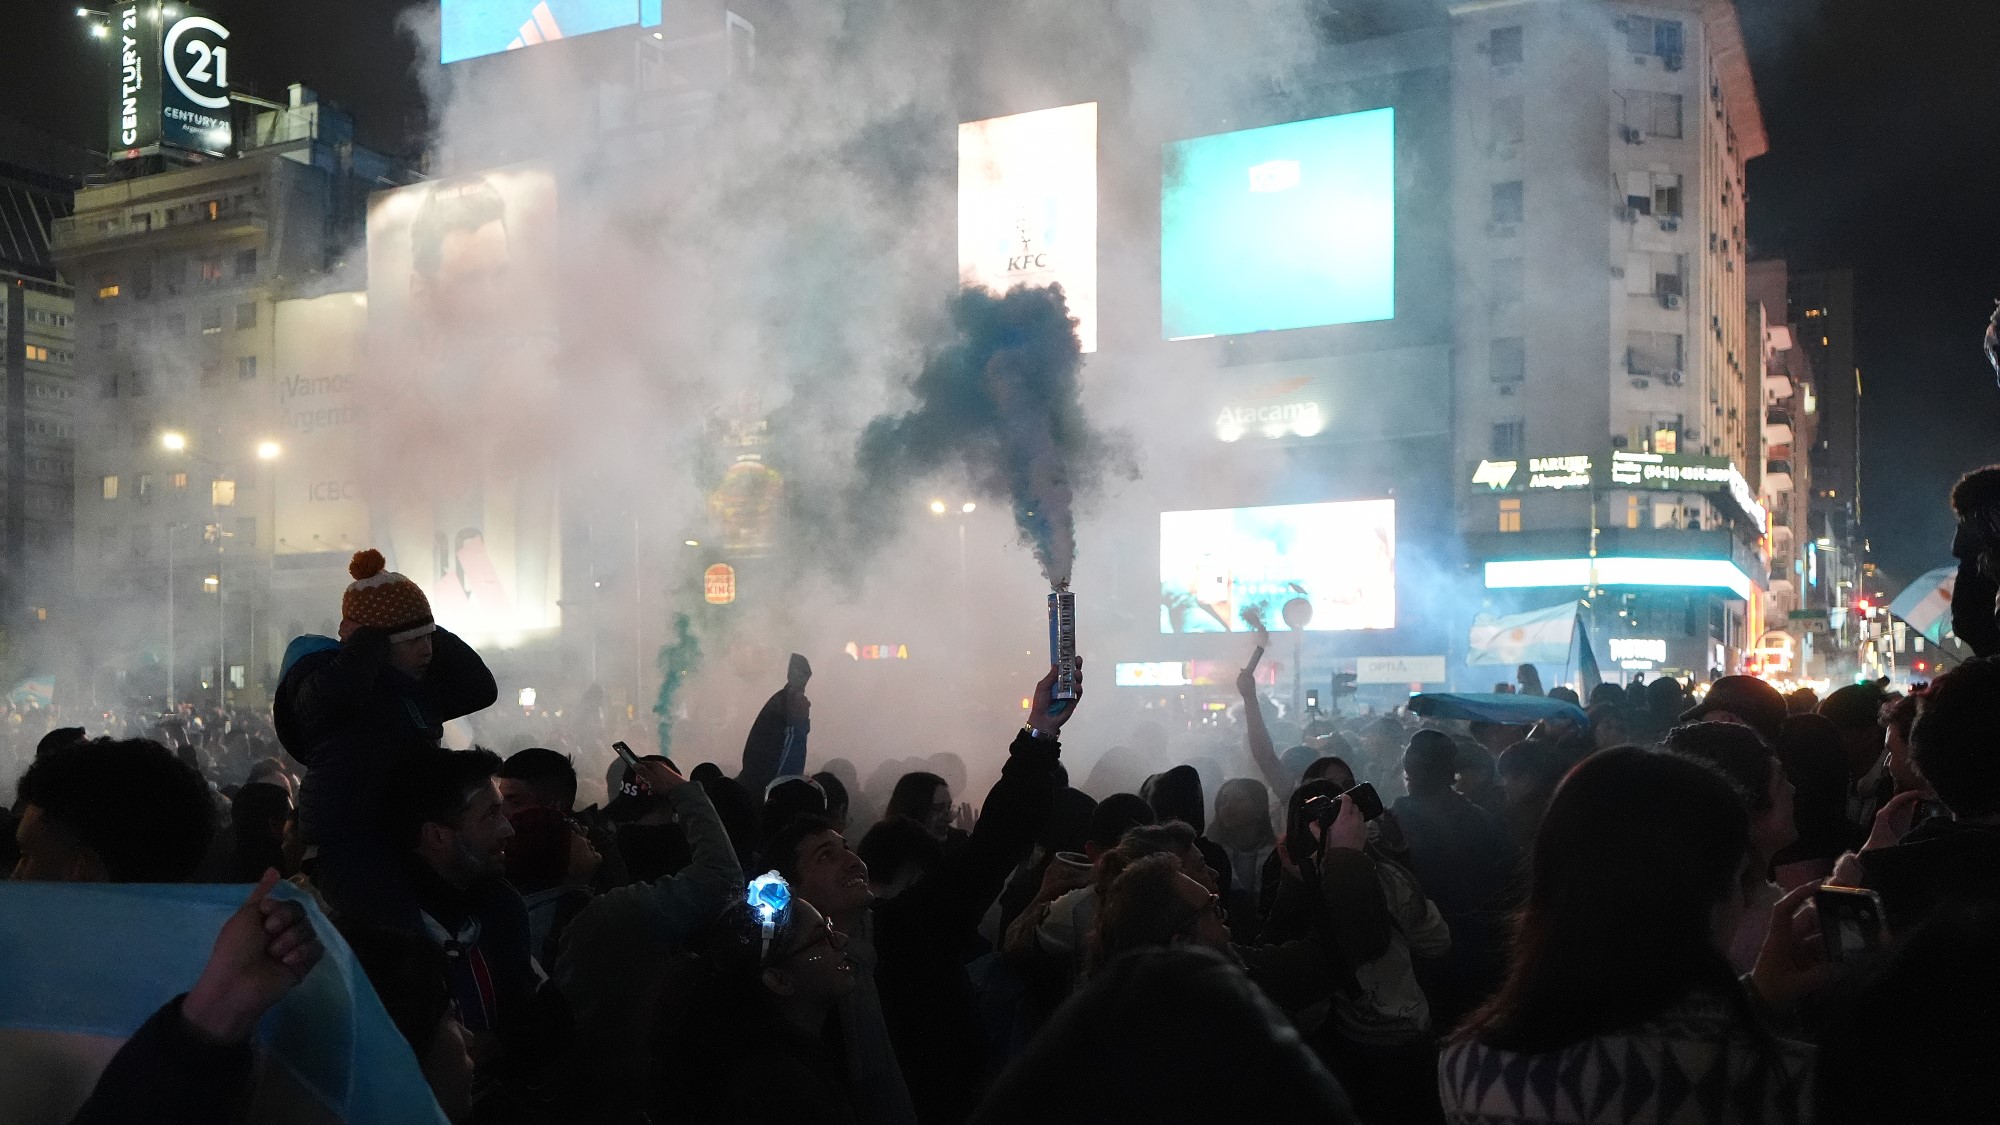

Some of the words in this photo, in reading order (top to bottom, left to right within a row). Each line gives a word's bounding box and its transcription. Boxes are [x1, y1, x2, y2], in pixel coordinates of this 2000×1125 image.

[122, 36, 137, 145] CENTURY
[163, 106, 218, 127] CENTURY
[1007, 253, 1047, 271] KFC
[1215, 401, 1321, 425] Atacama
[308, 480, 357, 502] ICBC
